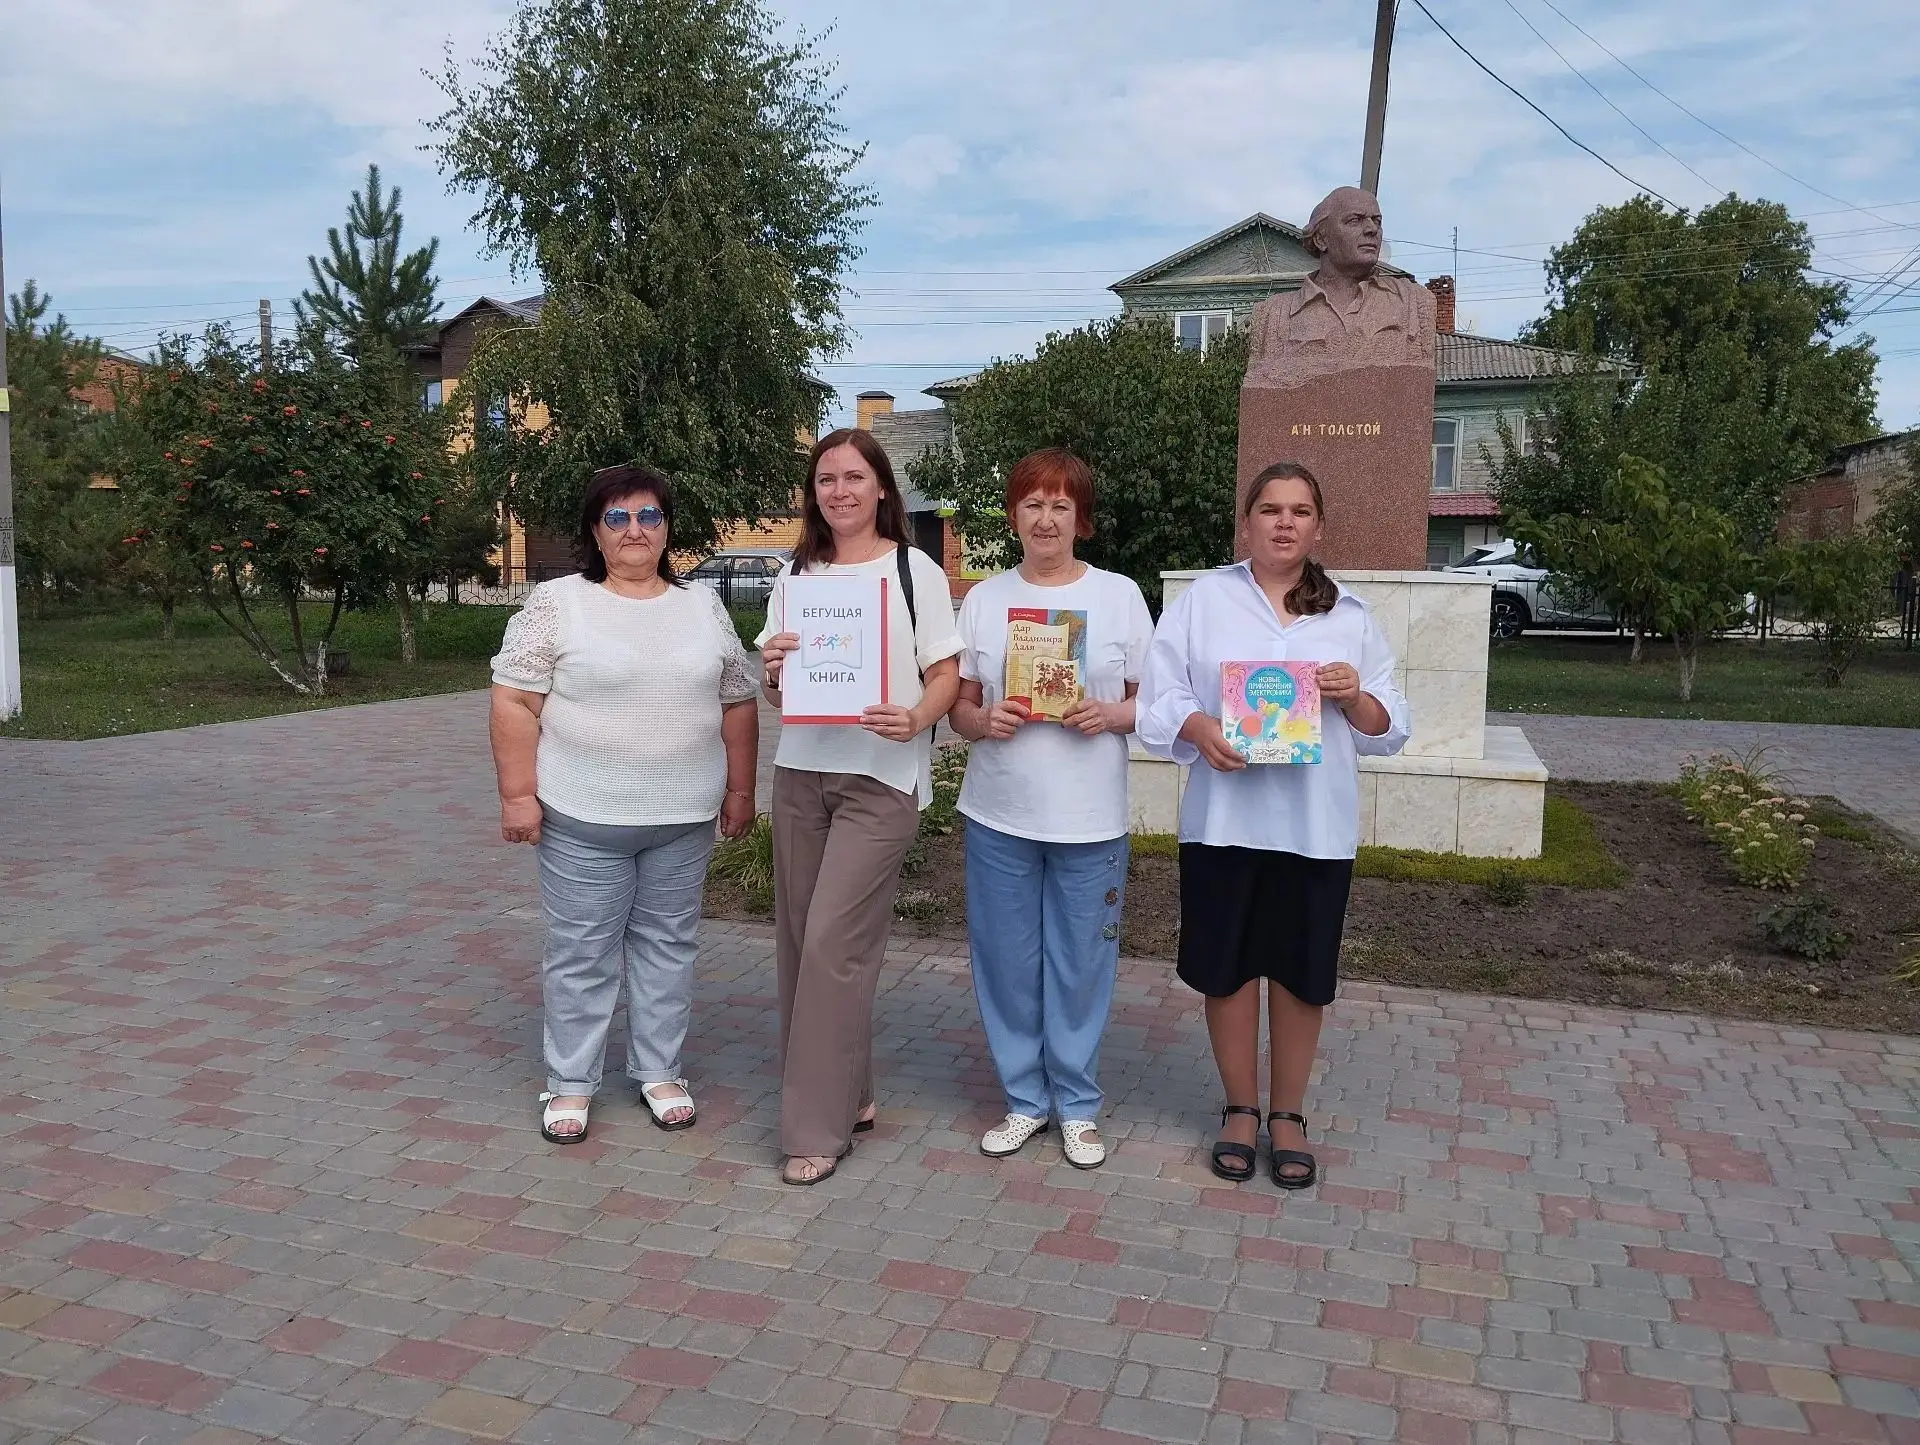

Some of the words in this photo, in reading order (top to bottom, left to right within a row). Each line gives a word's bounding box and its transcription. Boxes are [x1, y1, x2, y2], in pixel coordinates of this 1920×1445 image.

[1319, 421, 1381, 436] ТОЛСТОЙ
[802, 607, 862, 620] БЕГУЩАЯ
[1012, 623, 1031, 633] Дар
[1013, 633, 1063, 645] Владимира
[1012, 642, 1035, 651] Даля
[809, 671, 856, 683] КНИГА
